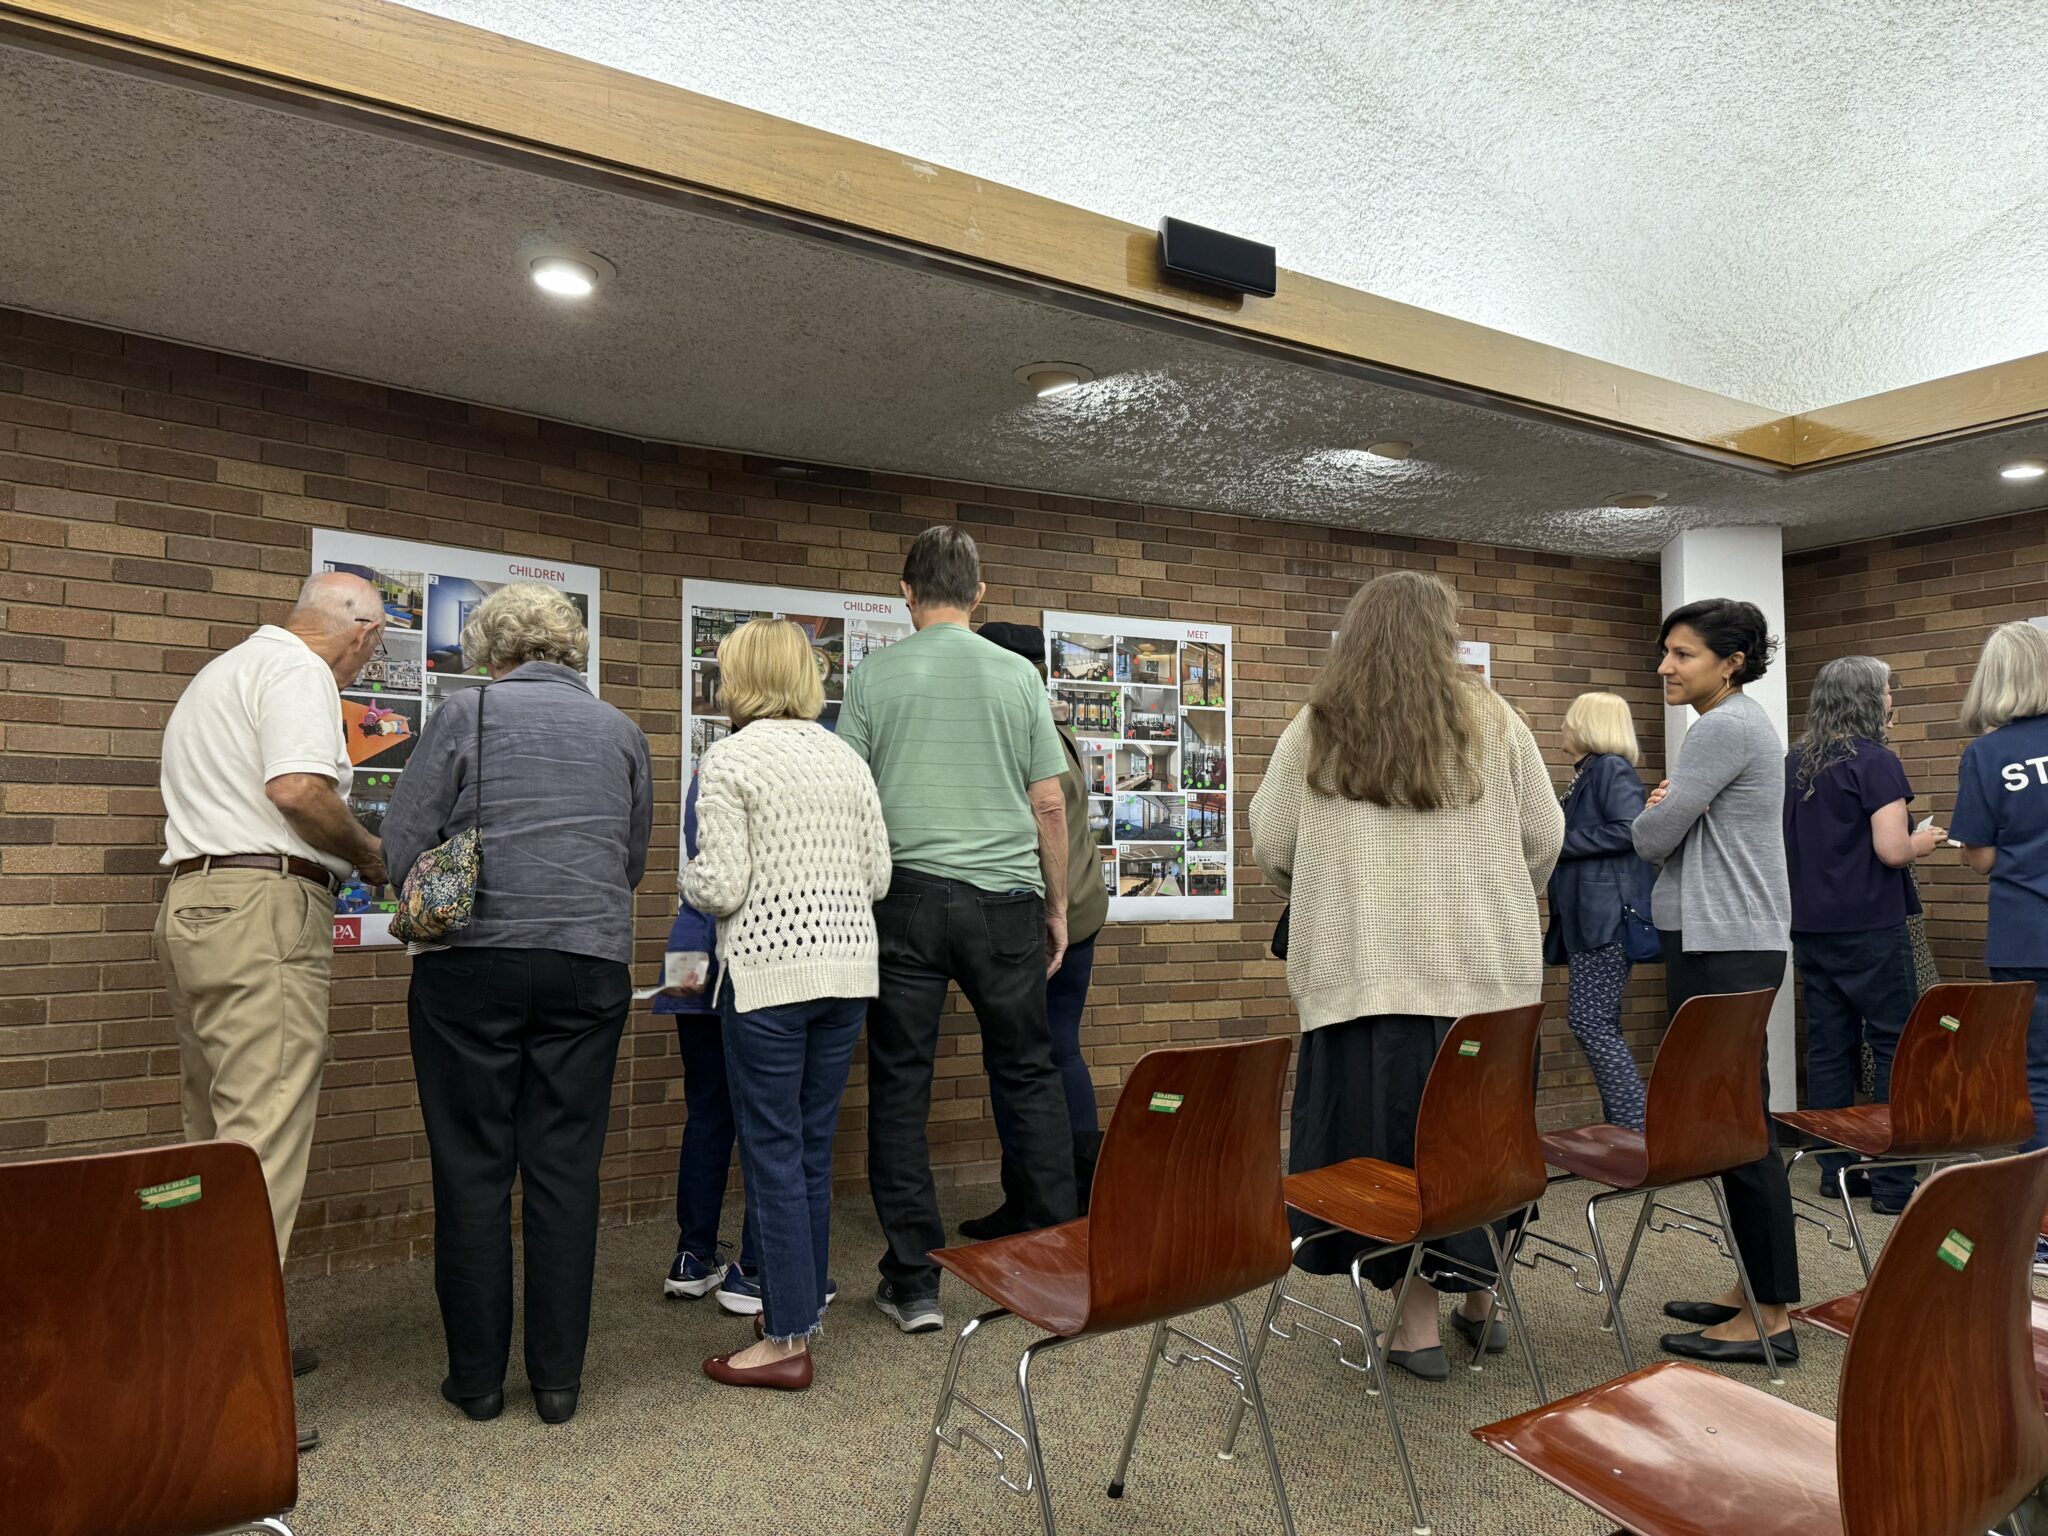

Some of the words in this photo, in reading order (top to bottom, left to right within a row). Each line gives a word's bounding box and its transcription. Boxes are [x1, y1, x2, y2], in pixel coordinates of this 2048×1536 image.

[508, 564, 565, 582] CHILDREN
[843, 601, 892, 614] CHILDREN
[1187, 630, 1209, 640] MEET
[2001, 755, 2048, 792] ST
